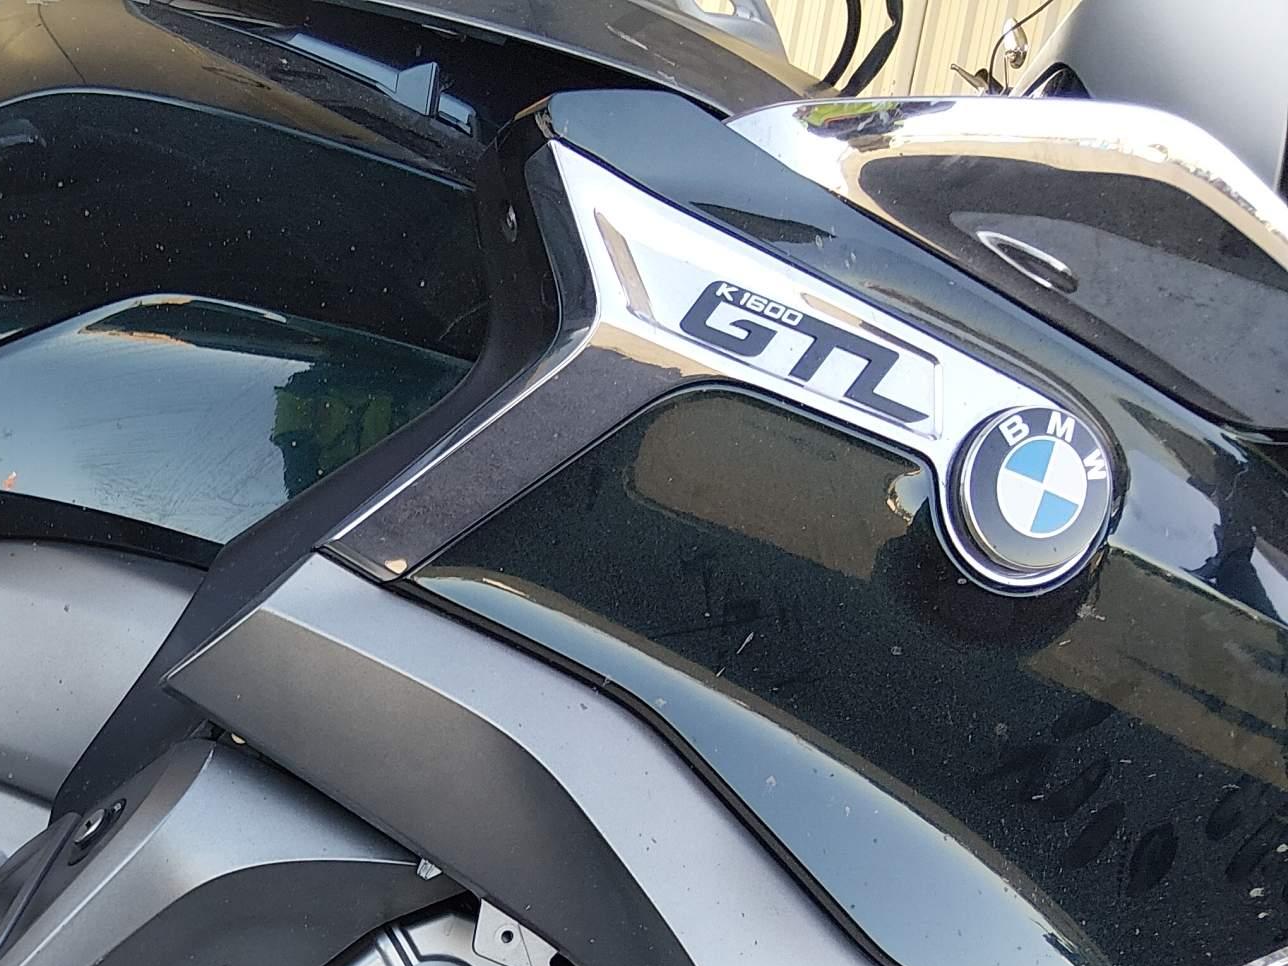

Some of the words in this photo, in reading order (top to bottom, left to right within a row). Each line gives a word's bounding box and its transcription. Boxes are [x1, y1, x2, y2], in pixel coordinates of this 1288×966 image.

[716, 282, 739, 302] K
[739, 290, 805, 327] 1600
[680, 280, 929, 423] GTL
[998, 411, 1108, 481] BMW
